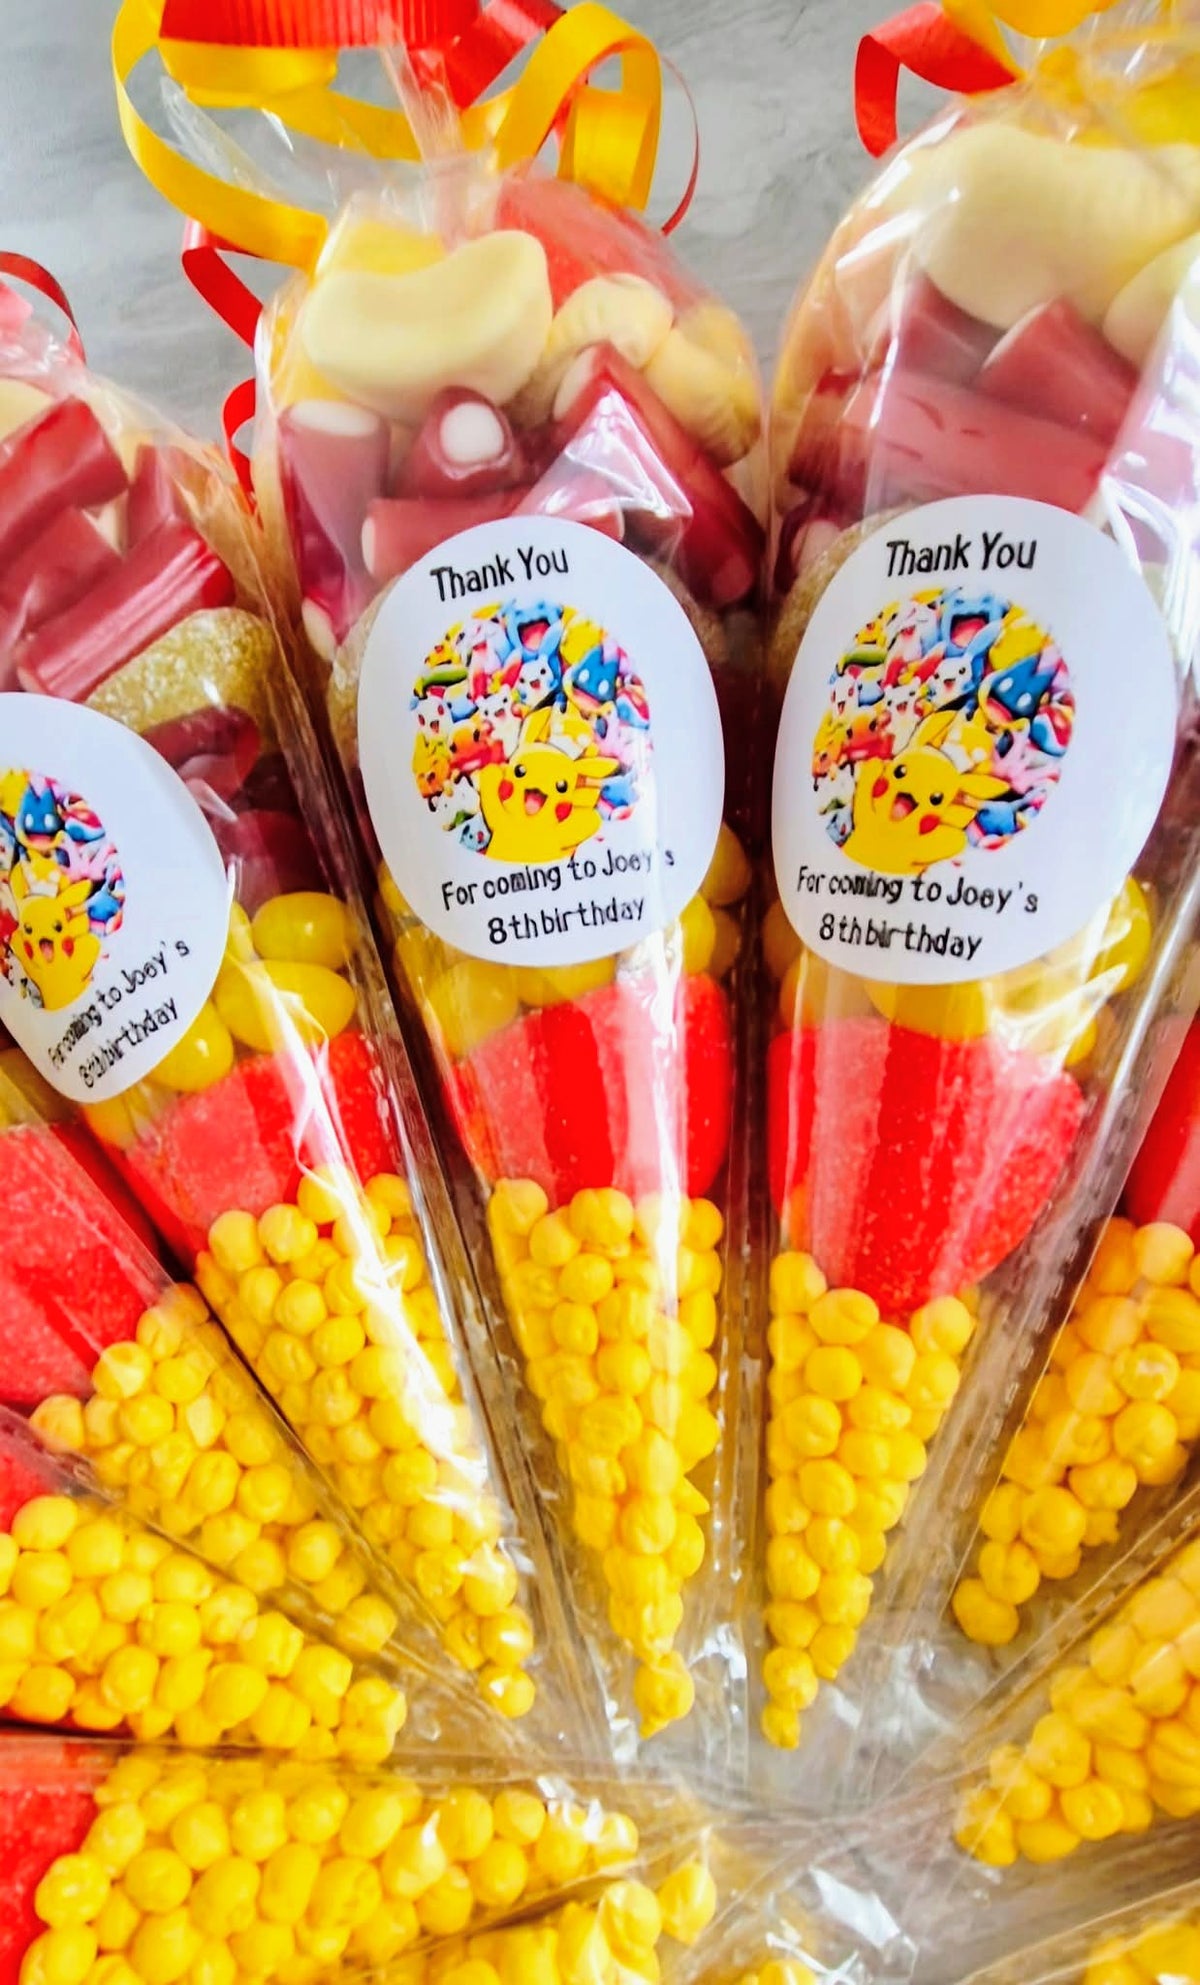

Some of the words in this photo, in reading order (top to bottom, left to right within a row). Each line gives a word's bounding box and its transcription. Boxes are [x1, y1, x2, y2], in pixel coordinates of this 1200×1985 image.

[429, 554, 515, 602] Thank
[517, 546, 569, 581] You
[886, 533, 972, 577] Thank
[981, 531, 1037, 571] You
[441, 881, 478, 911] For
[483, 866, 562, 899] coming
[567, 856, 597, 881] to
[797, 866, 827, 894] For
[828, 871, 904, 904] coming
[911, 873, 942, 902] to
[946, 877, 1039, 914] Joey's
[96, 986, 122, 1010] to
